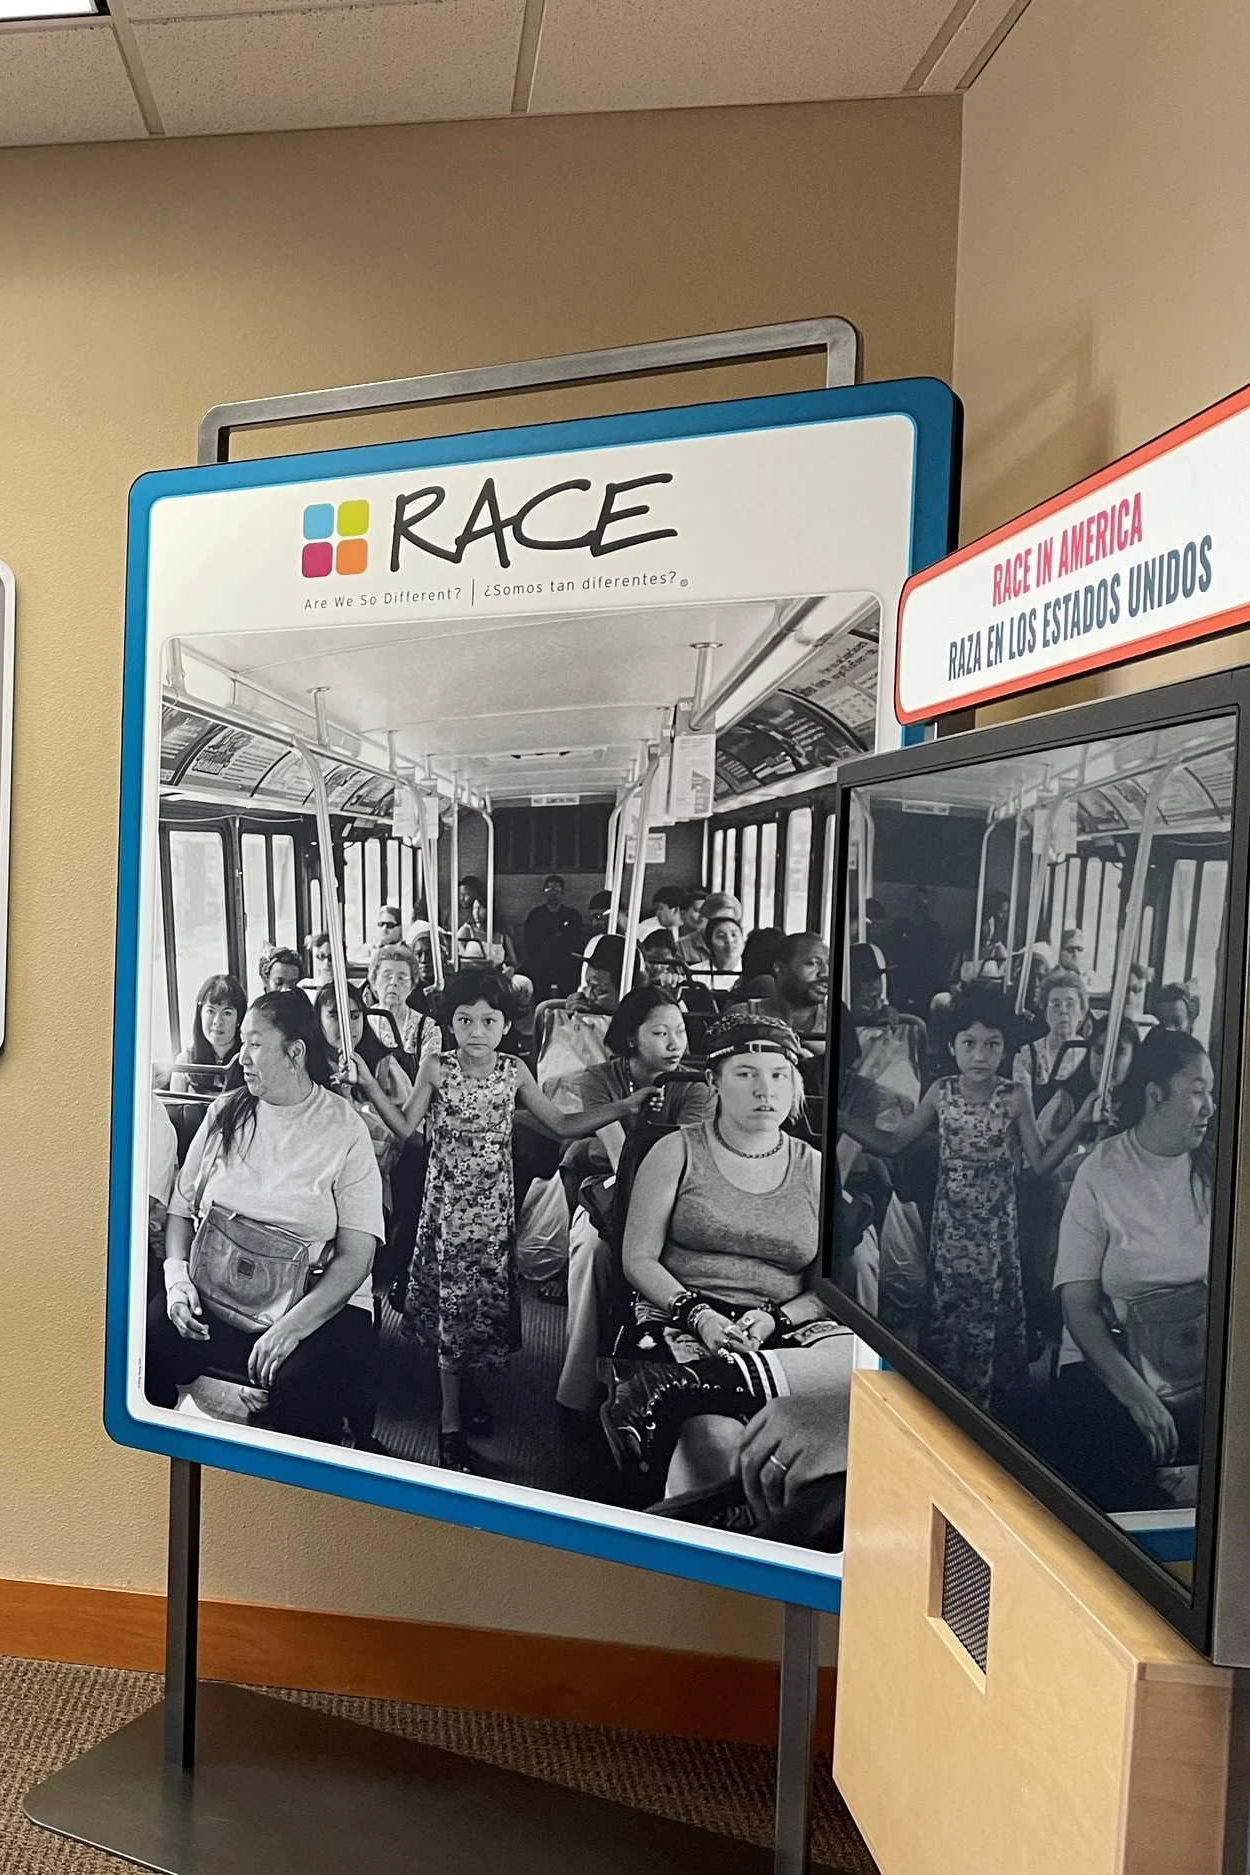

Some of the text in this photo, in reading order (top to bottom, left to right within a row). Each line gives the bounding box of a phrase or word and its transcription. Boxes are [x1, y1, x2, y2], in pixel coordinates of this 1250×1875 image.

[390, 473, 678, 572] RACE
[992, 492, 1143, 607] RACE IN AMERICA
[304, 586, 462, 610] Are We So Different?
[483, 571, 677, 598] ¿Somos tan diferentes?
[948, 534, 1213, 681] RAZA EN LOS ESTADOS UNIDOS
